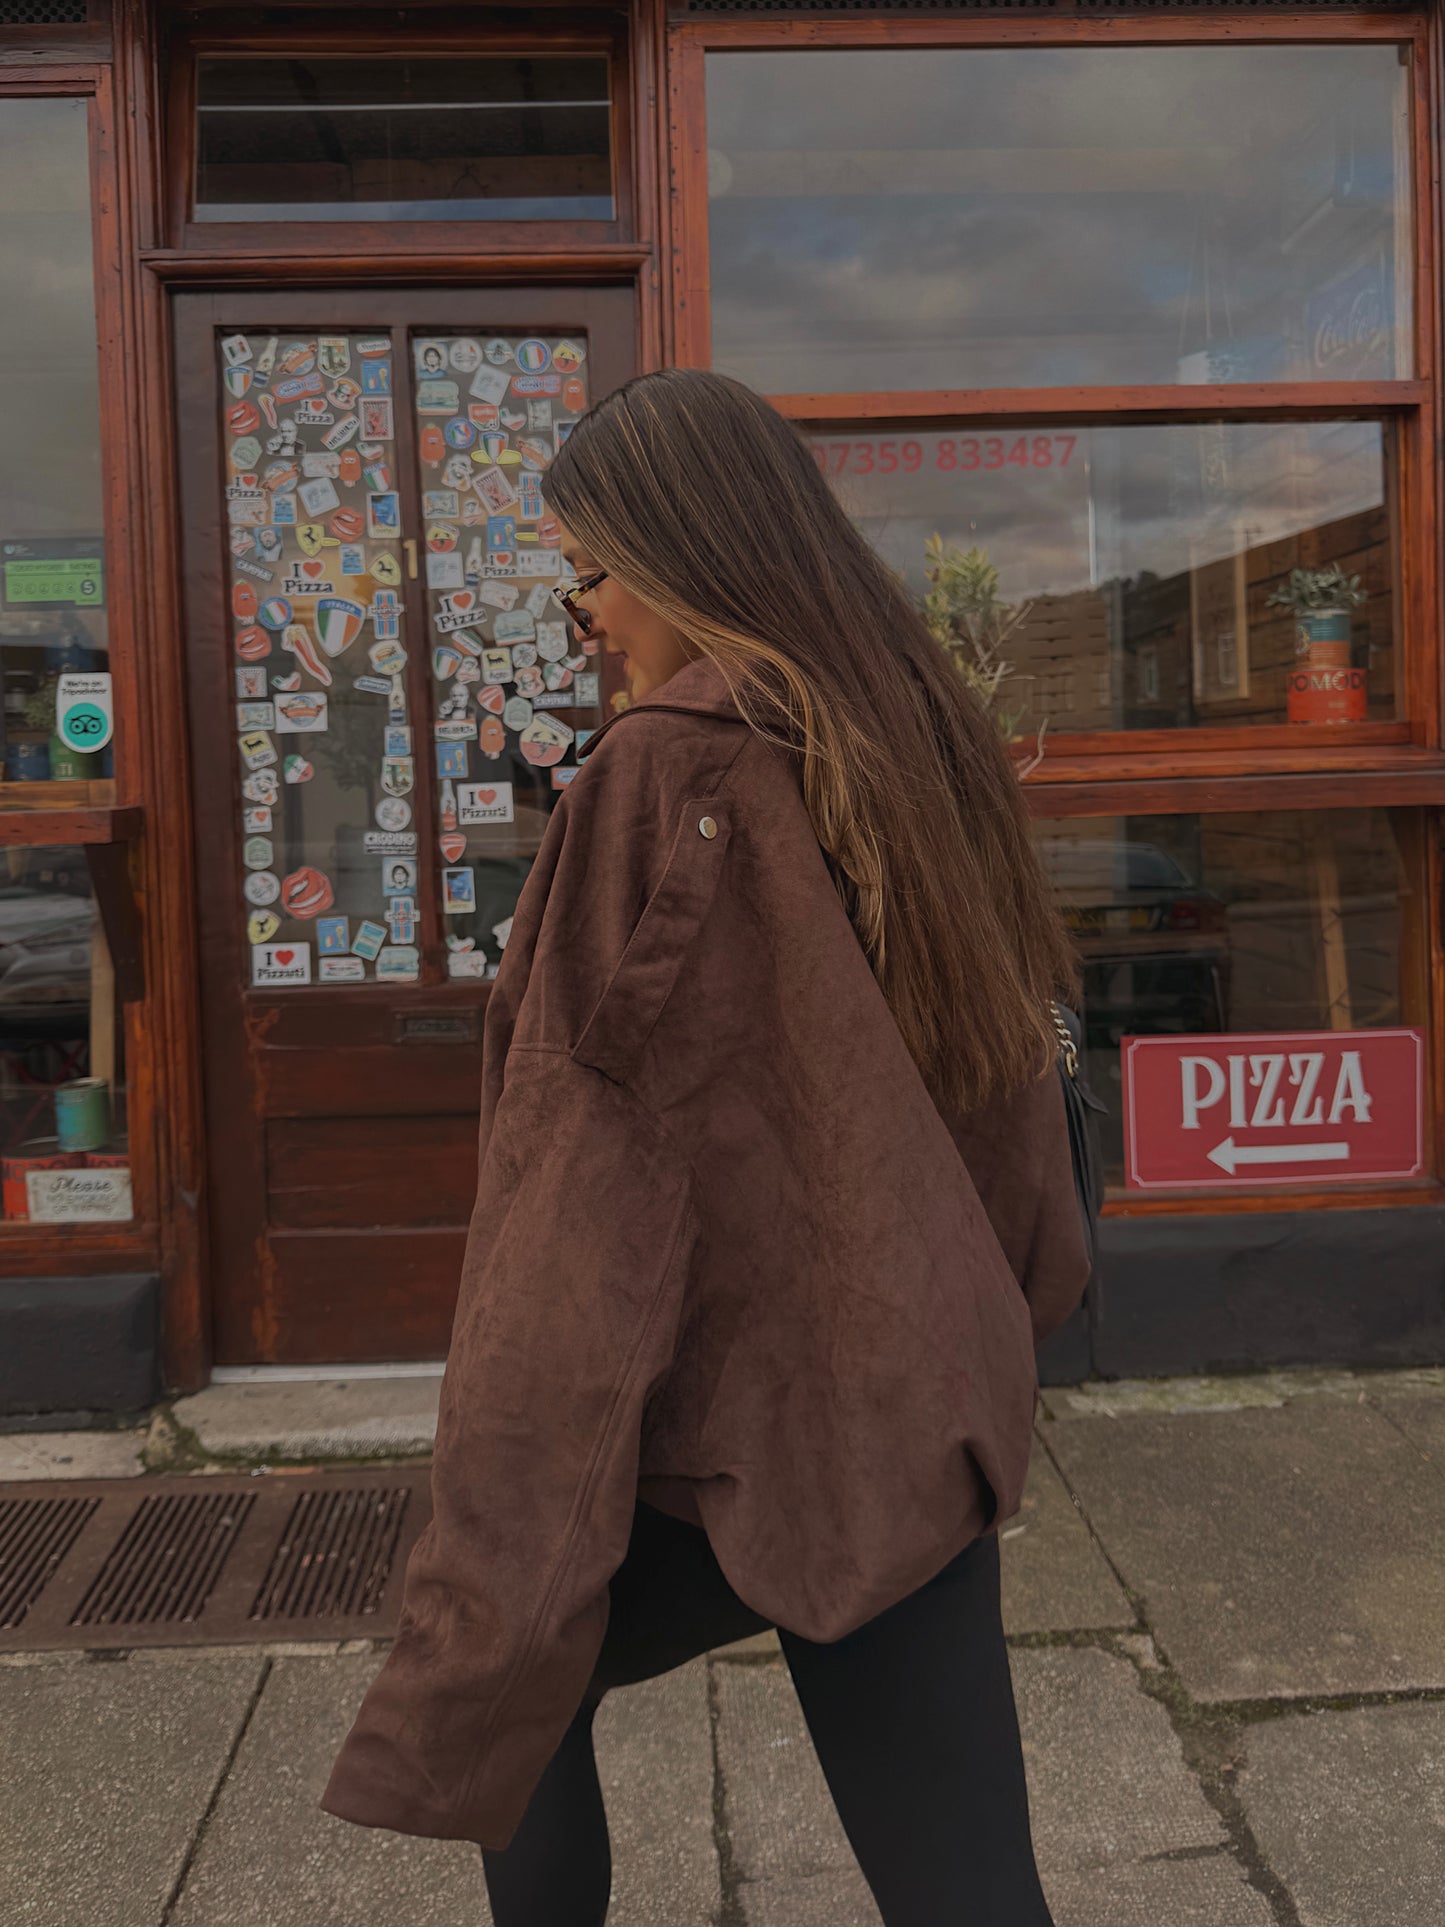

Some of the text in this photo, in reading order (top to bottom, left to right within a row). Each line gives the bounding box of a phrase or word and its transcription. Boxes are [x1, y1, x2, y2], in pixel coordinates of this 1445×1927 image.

[298, 412, 331, 422] Pizza
[936, 435, 1077, 472] 833487
[228, 488, 263, 498] Pizza
[293, 563, 301, 578] I
[483, 565, 517, 577] Pizza
[284, 580, 333, 593] Pizza
[438, 609, 487, 629] Pizza
[1179, 1050, 1374, 1129] PIZZA
[49, 1176, 113, 1193] Please
